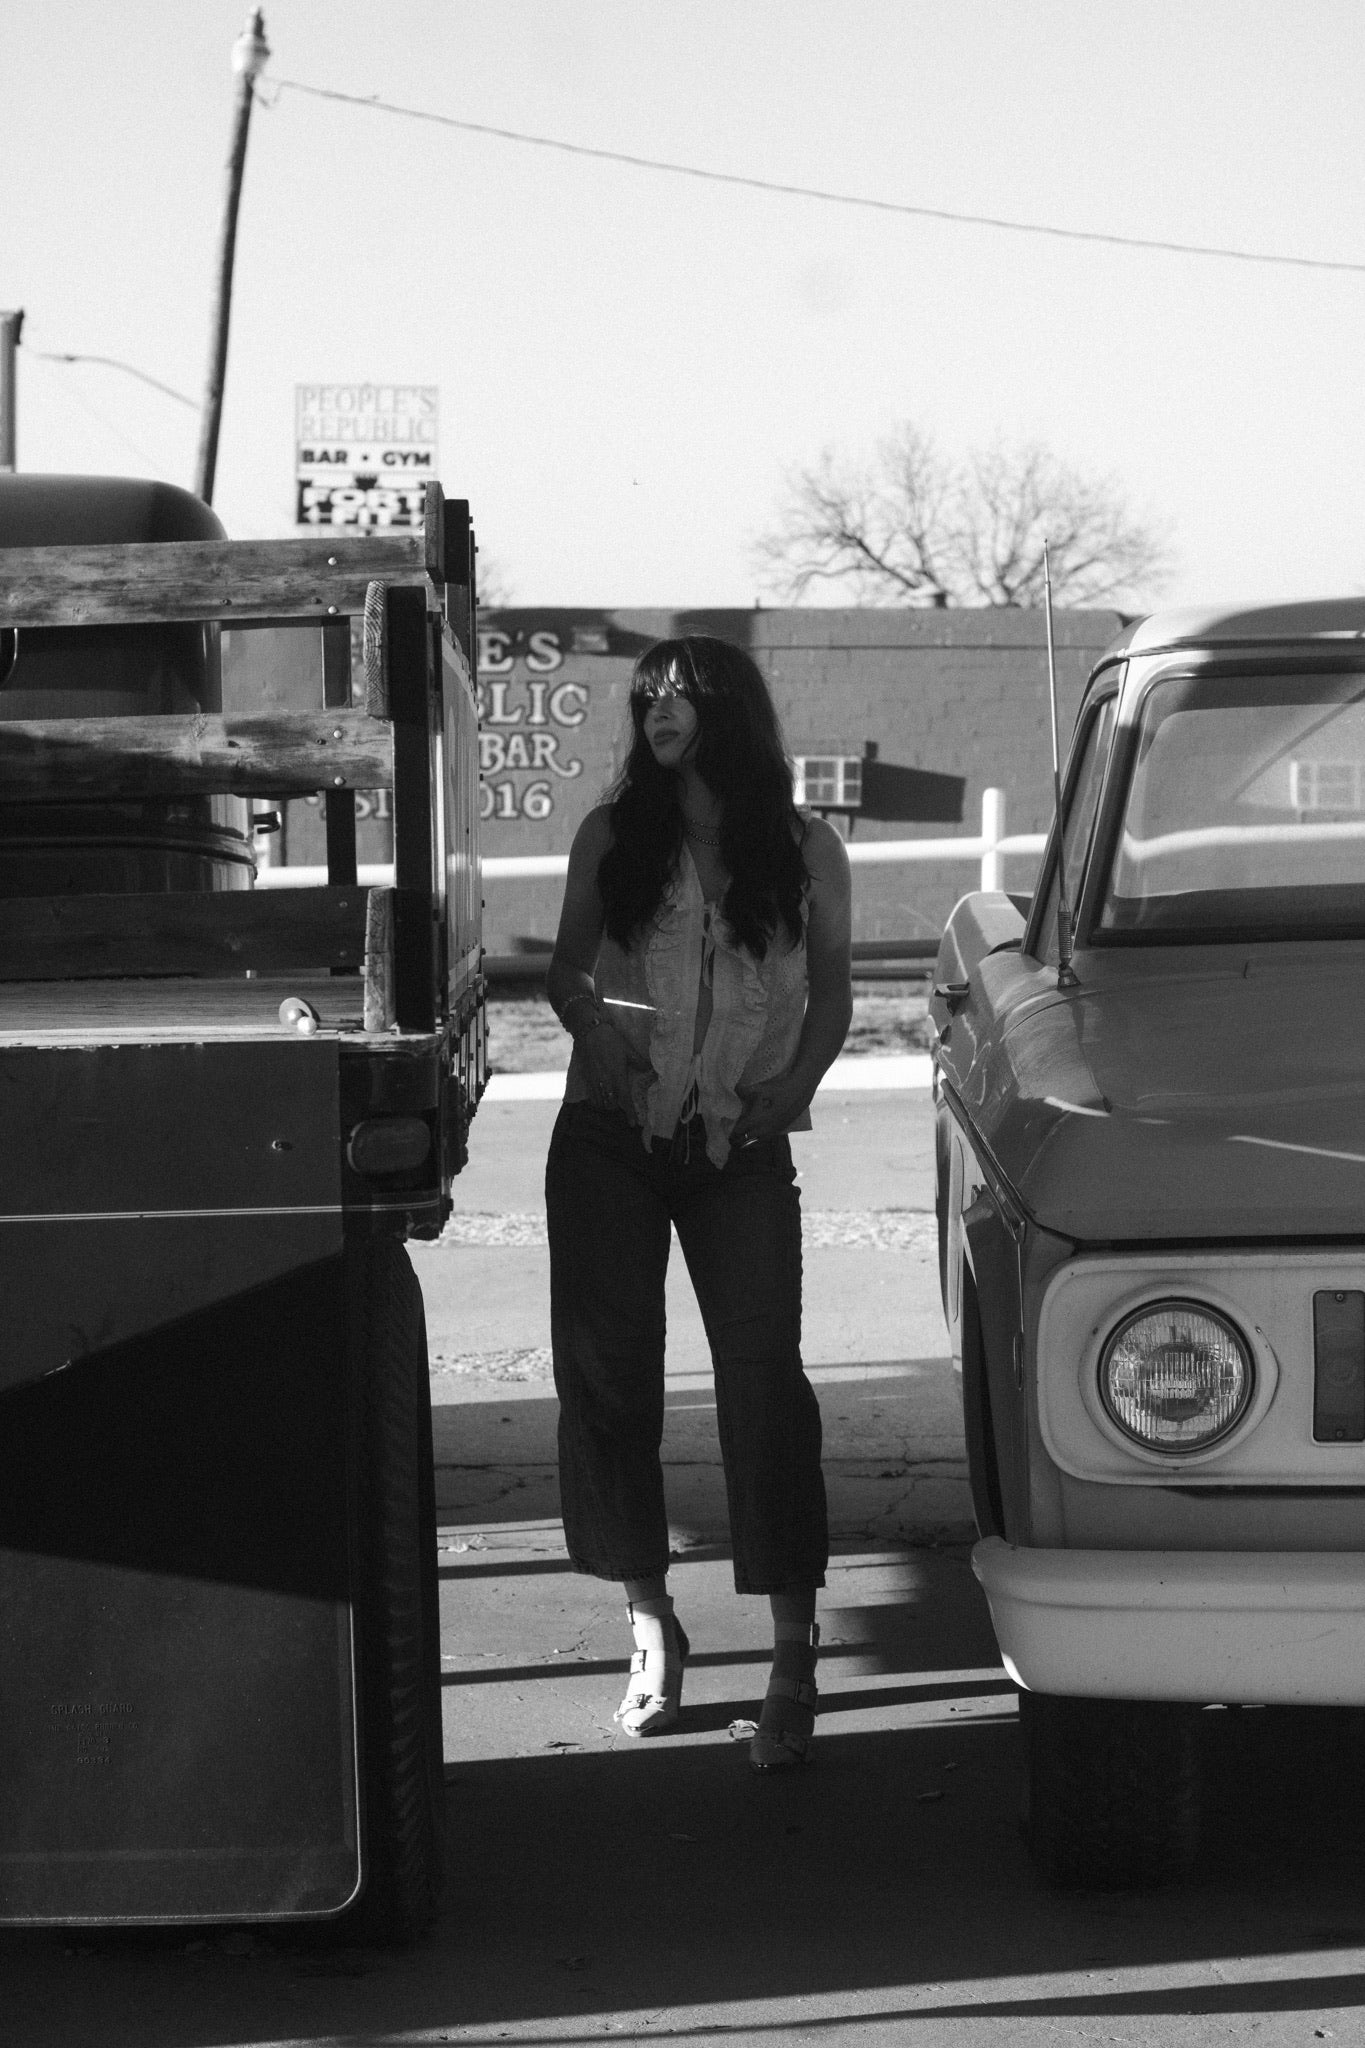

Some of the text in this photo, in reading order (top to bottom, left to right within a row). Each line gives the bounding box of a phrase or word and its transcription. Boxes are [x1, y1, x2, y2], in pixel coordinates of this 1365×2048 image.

[301, 388, 436, 414] PEOPLE'S
[301, 416, 433, 441] REPUBLIC
[302, 450, 431, 466] BAR GYM
[302, 488, 427, 513] FORT
[50, 1704, 92, 1715] SPLASH
